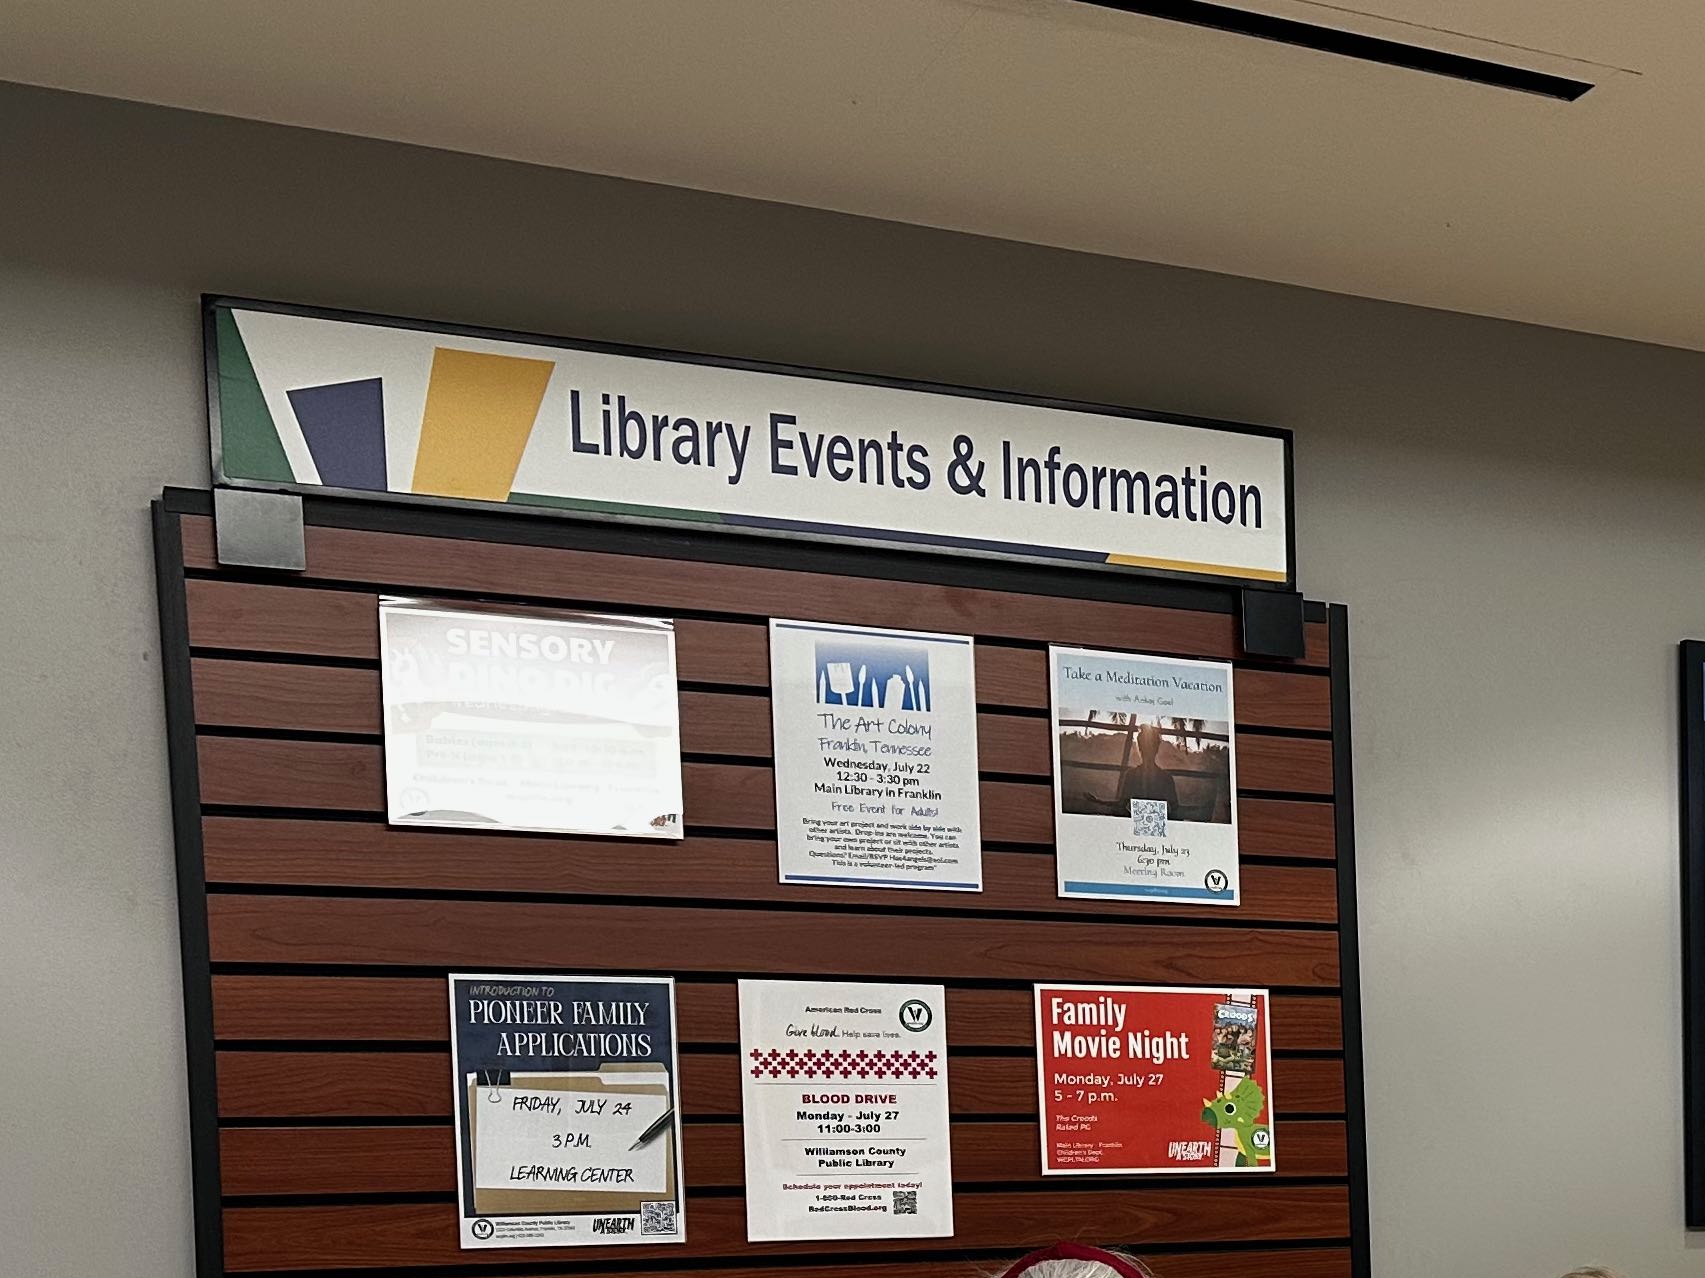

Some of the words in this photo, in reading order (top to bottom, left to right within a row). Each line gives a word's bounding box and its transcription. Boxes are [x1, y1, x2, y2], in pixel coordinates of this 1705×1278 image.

[570, 389, 751, 485] Library
[769, 412, 931, 490] Events
[947, 434, 986, 498] &
[1002, 440, 1262, 529] Information
[445, 627, 615, 665] SENSORY
[1063, 667, 1091, 682] Take
[1095, 673, 1102, 682] a
[1106, 671, 1169, 689] Meditation
[1173, 677, 1223, 693] Vacation
[817, 713, 851, 730] The
[855, 717, 884, 733] Art
[888, 718, 932, 740] Colony
[869, 741, 932, 757] Tennessee
[893, 762, 914, 774] July
[917, 764, 931, 774] 22
[837, 771, 868, 782] 12:30
[877, 774, 901, 784] 3:30
[903, 777, 920, 787] pm
[814, 783, 842, 794] Main
[845, 785, 883, 798] Library
[885, 787, 895, 797] in
[898, 788, 942, 800] Franklin
[832, 801, 855, 812] Free
[859, 803, 885, 814] Event
[1162, 844, 1179, 856] July
[1124, 866, 1157, 878] Meeting
[1160, 868, 1185, 878] Room
[470, 985, 540, 997] INTRODUCTION
[541, 987, 554, 997] TO
[469, 1000, 564, 1025] PIONEER
[573, 1001, 649, 1026] FAMILY
[804, 1006, 842, 1014] American
[1051, 996, 1127, 1032] Family
[785, 1023, 808, 1038] Give
[842, 1030, 860, 1039] Help
[497, 1032, 652, 1057] APPLICATIONS
[1052, 1029, 1121, 1059] Movie
[1128, 1030, 1190, 1064] Night
[1054, 1073, 1114, 1087] Monday,
[1117, 1073, 1145, 1088] July
[1148, 1074, 1164, 1086] 27
[802, 1094, 851, 1104] BLOOD
[854, 1094, 897, 1104] DRIVE
[1054, 1090, 1063, 1101] 5
[1075, 1090, 1084, 1101] 7
[1088, 1090, 1119, 1104] p.m.
[512, 1096, 562, 1115] FRIDAY,
[575, 1098, 607, 1115] JULY
[612, 1102, 632, 1115] 24
[796, 1111, 845, 1122] Monday
[855, 1111, 882, 1122] July
[884, 1111, 900, 1121] 27
[1056, 1114, 1070, 1122] The
[1071, 1114, 1098, 1122] Croods
[817, 1124, 881, 1134] 11:00-3:00
[1056, 1123, 1079, 1131] Rated
[804, 1147, 865, 1157] Williamson
[868, 1147, 907, 1158] County
[1168, 1141, 1212, 1158] UNEARTH
[818, 1159, 852, 1168] Public
[855, 1159, 895, 1169] Library
[510, 1165, 577, 1182] LEARNING
[580, 1167, 635, 1183] CENTER
[782, 1182, 821, 1191] Schedule
[843, 1182, 896, 1191] appointment
[592, 1217, 636, 1233] UNEARTH
